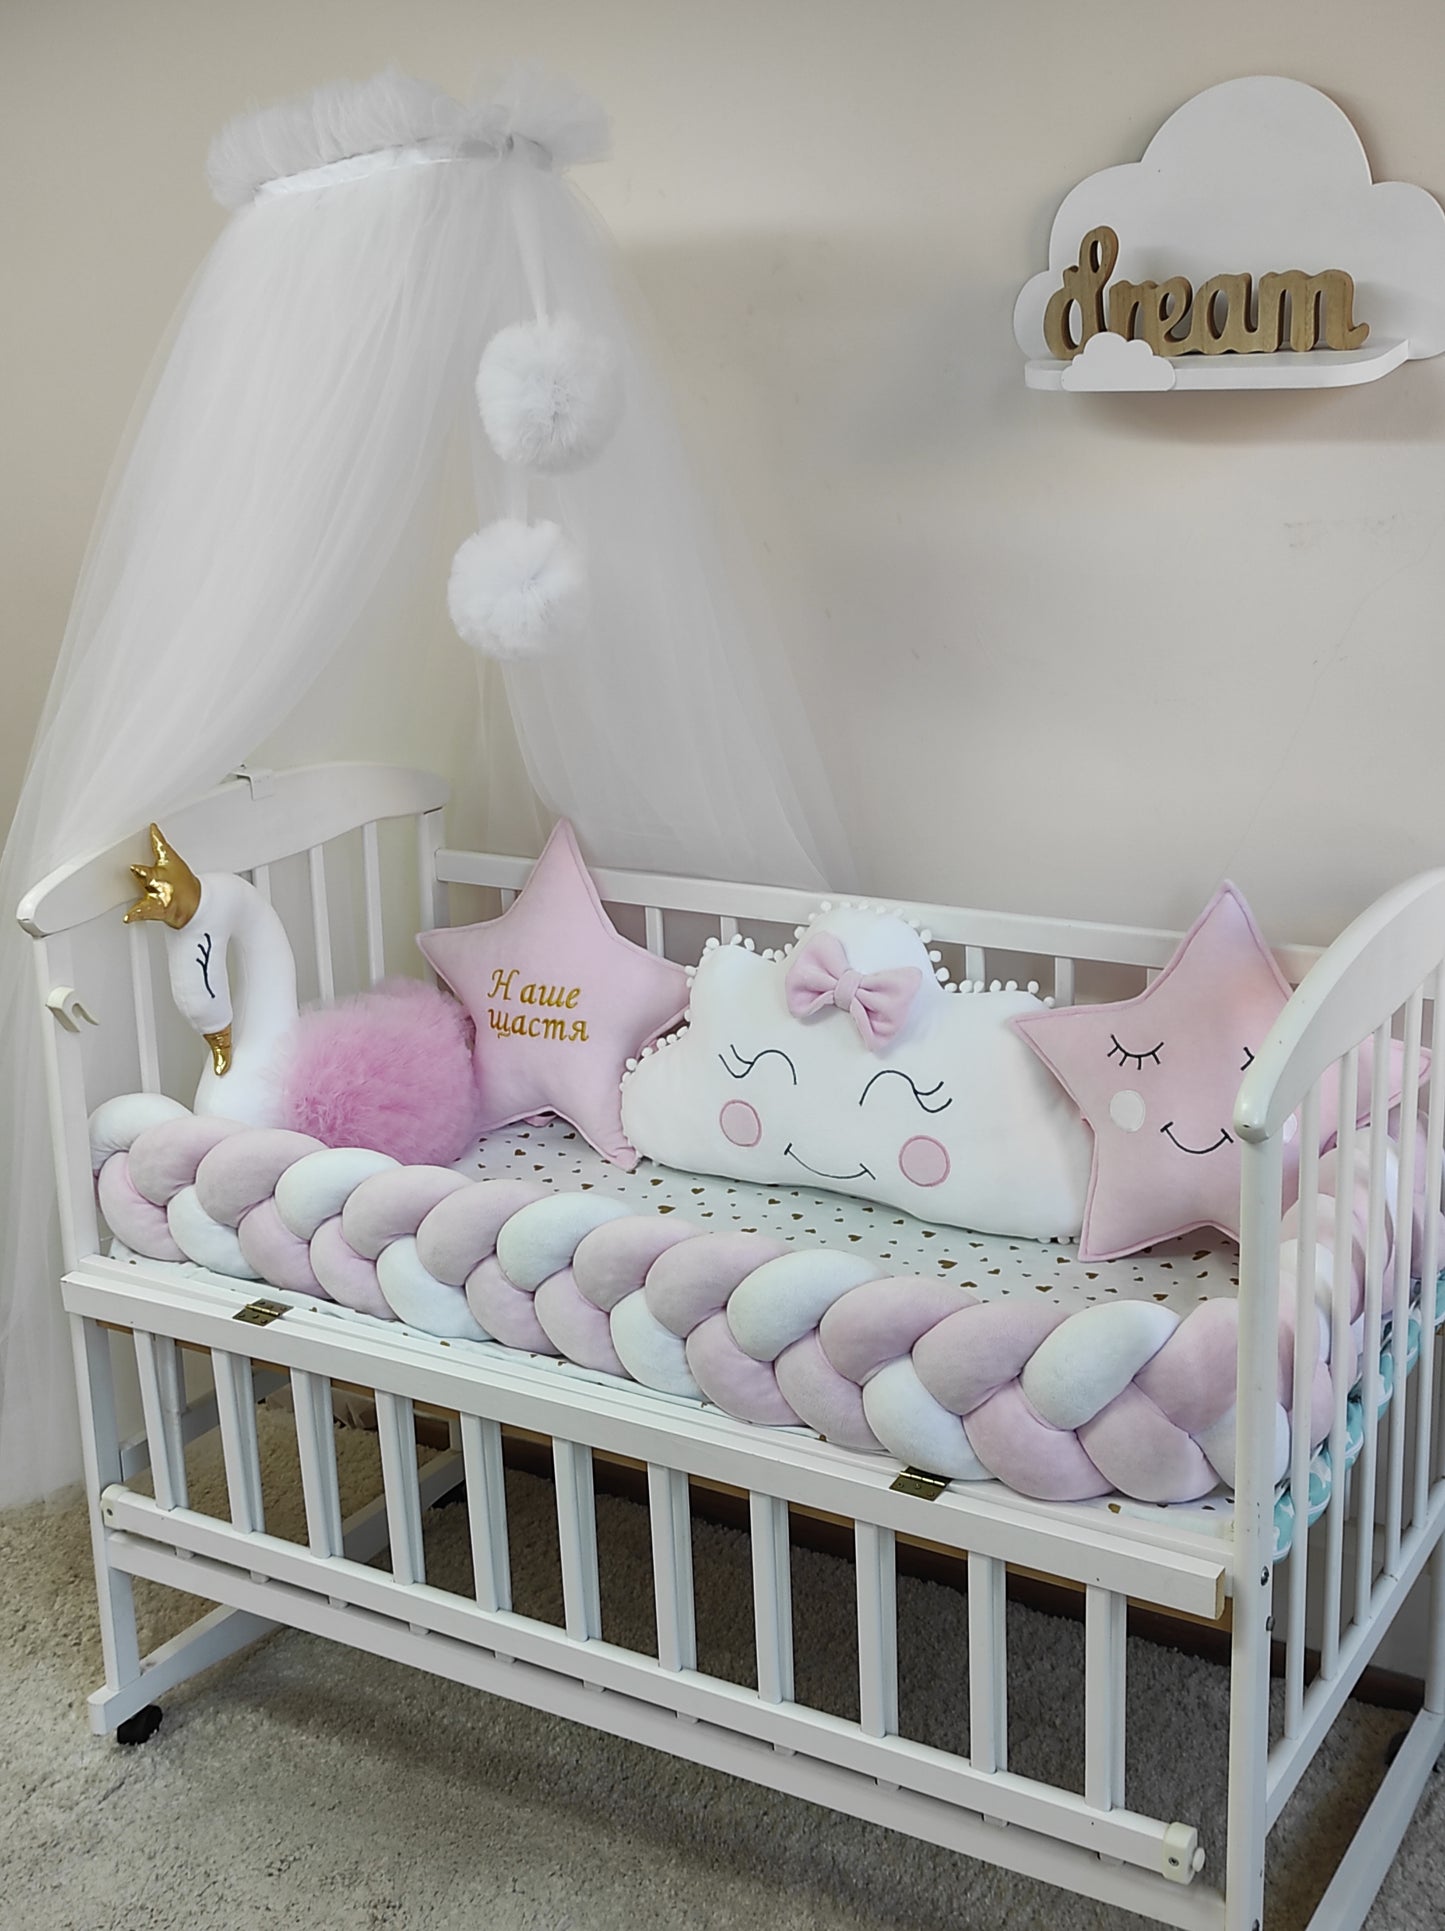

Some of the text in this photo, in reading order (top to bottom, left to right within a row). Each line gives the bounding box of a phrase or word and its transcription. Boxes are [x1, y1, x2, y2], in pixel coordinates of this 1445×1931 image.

[1043, 226, 1370, 359] dream
[487, 969, 581, 1009] Наше
[488, 1008, 589, 1042] щастя
